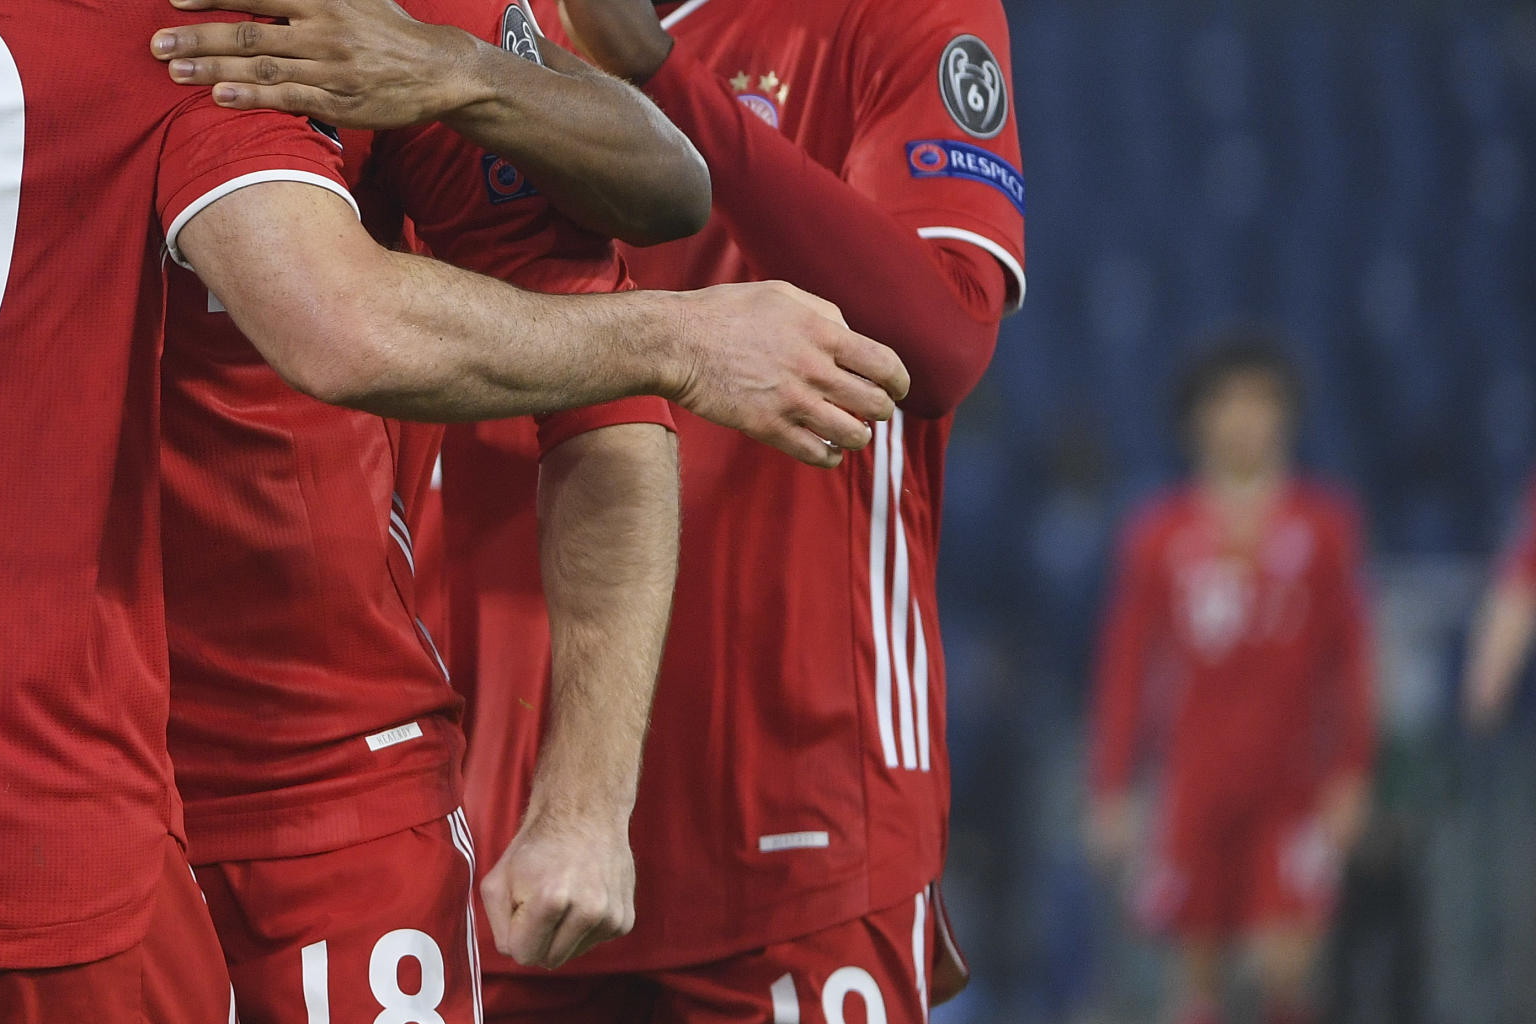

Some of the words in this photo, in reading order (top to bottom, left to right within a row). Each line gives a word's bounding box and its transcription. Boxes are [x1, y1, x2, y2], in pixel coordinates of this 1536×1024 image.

[967, 83, 985, 113] 6
[950, 149, 1024, 203] RESPECT
[301, 928, 445, 1024] 18
